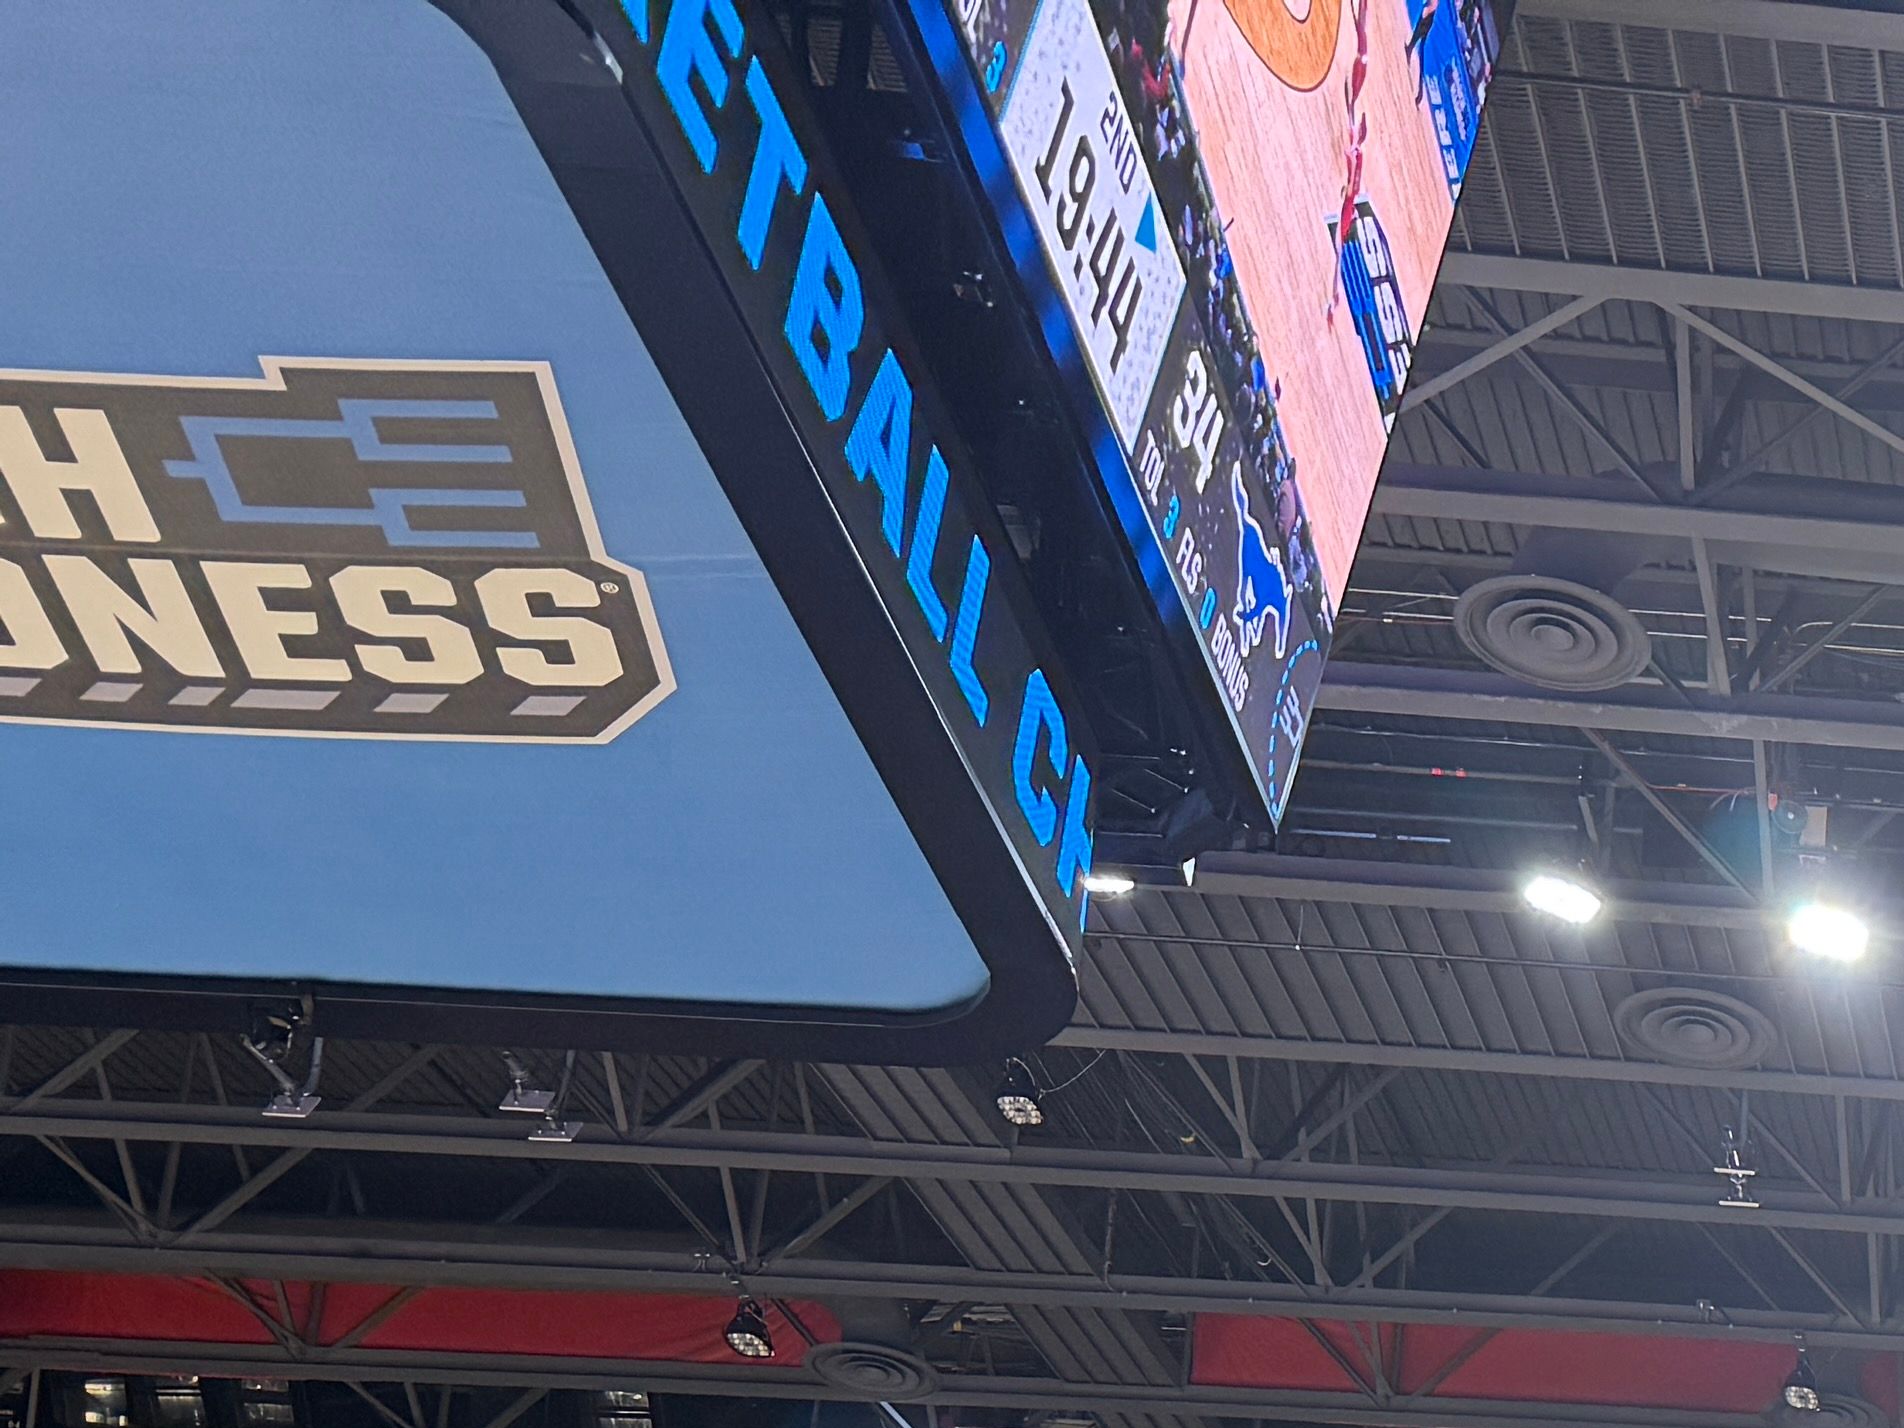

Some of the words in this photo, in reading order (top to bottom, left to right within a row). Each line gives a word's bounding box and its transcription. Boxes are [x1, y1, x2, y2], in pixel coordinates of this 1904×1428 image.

[986, 41, 1007, 94] 3
[1100, 90, 1138, 195] 2ND
[1035, 76, 1142, 376] 19:44
[1173, 349, 1225, 495] 34
[1139, 428, 1165, 506] TOL
[1163, 494, 1180, 541] 3
[1175, 526, 1203, 595] FLS
[1210, 613, 1251, 713] BONUS
